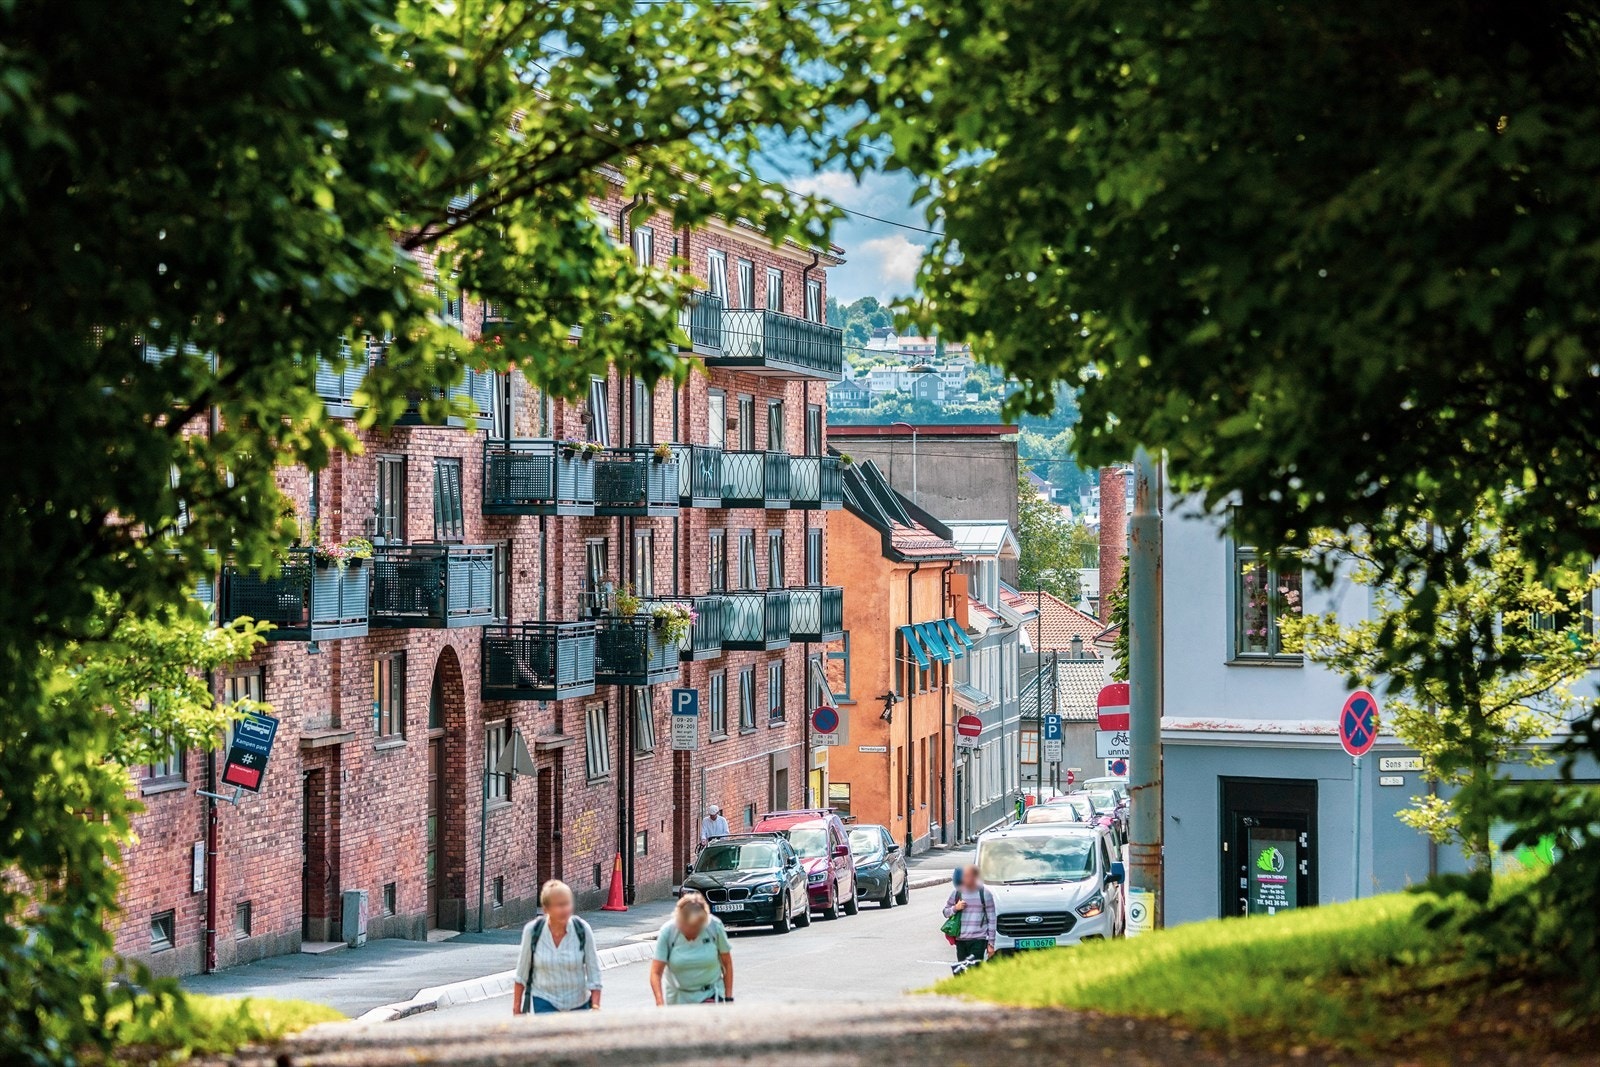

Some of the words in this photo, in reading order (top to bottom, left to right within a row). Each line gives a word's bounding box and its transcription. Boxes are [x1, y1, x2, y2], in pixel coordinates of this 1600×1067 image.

[678, 692, 692, 712] P
[1048, 725, 1057, 738] P
[236, 738, 255, 747] Kampen
[1385, 759, 1402, 768] Sons
